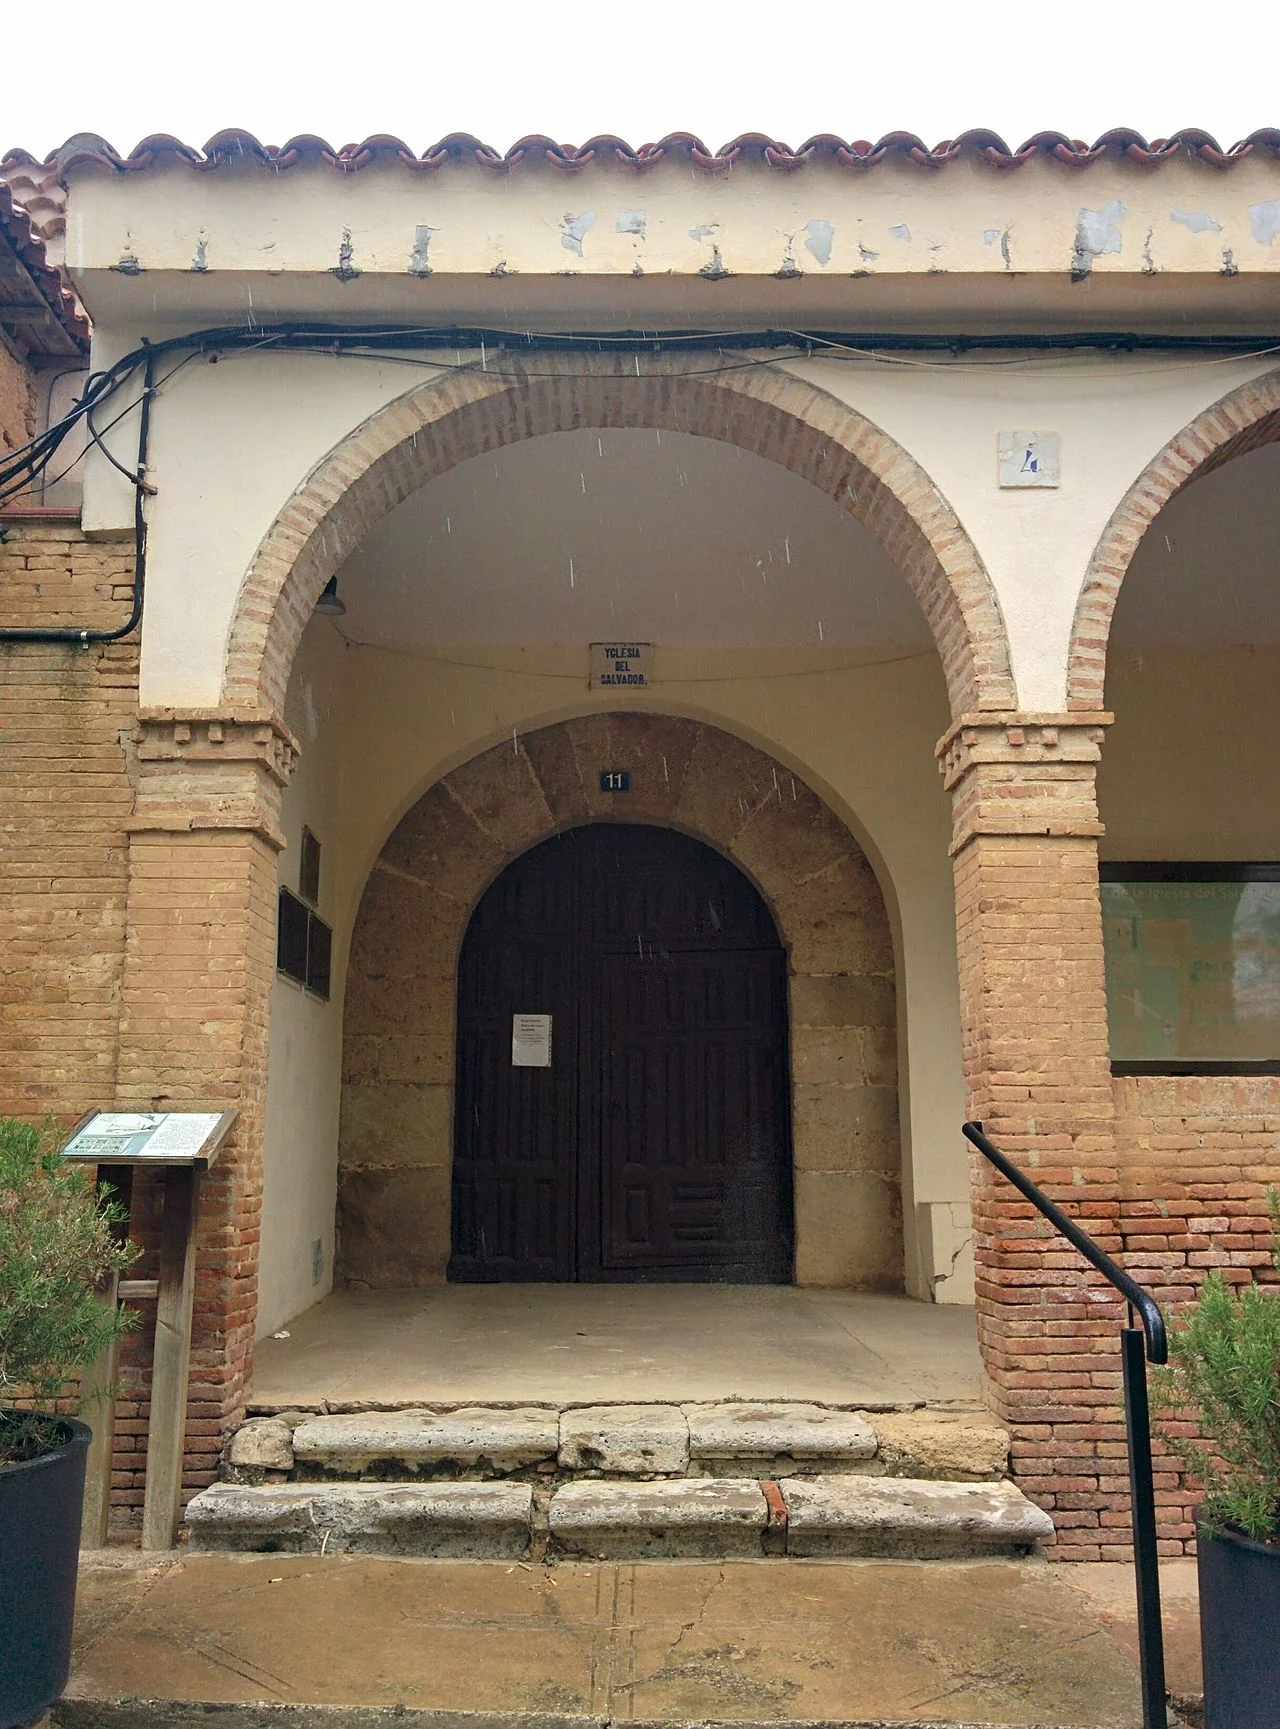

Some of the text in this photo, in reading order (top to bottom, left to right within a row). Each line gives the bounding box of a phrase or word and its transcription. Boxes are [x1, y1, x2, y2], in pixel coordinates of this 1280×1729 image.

[615, 660, 631, 672] DEL
[600, 674, 648, 685] SALVADOR.
[606, 773, 622, 788] 11
